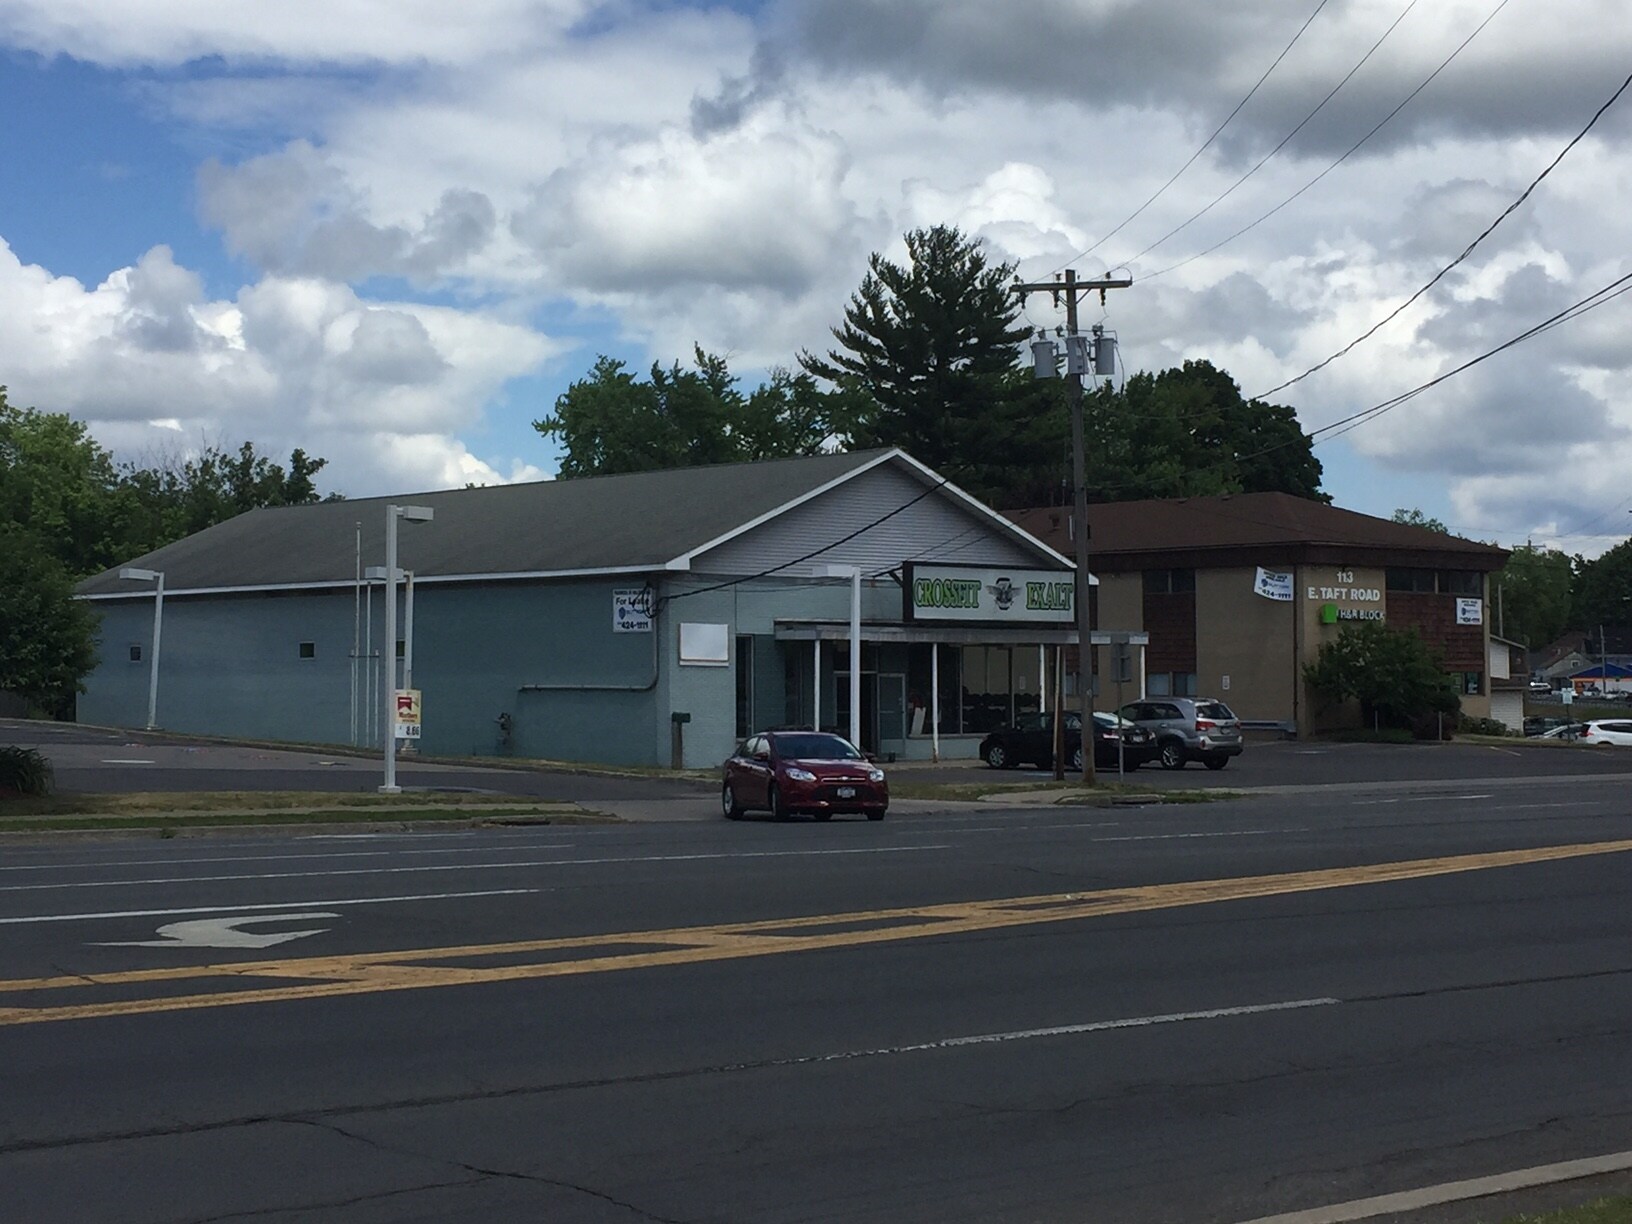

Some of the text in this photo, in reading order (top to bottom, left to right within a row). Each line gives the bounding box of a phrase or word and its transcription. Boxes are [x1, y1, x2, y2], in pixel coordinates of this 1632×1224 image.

[1336, 571, 1353, 583] 113
[1026, 582, 1074, 611] EXALT
[1308, 587, 1380, 601] E. TAFT ROAD
[615, 597, 627, 605] For
